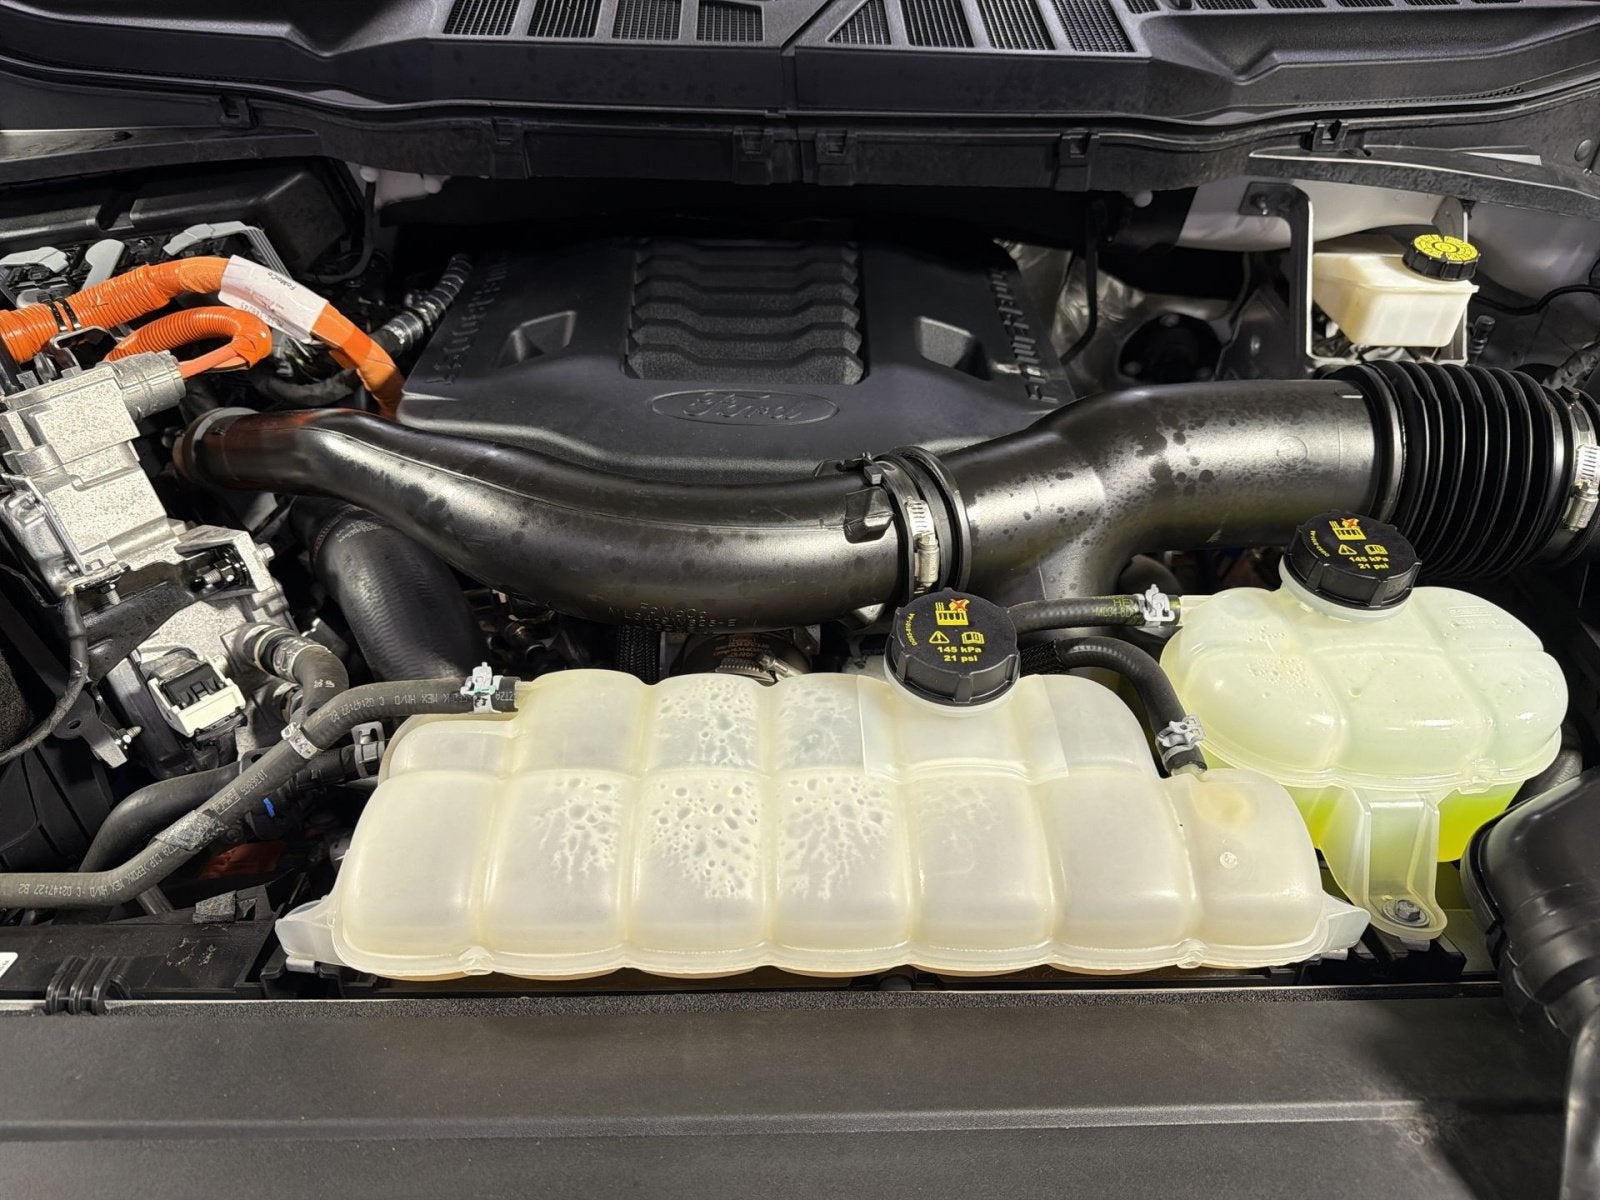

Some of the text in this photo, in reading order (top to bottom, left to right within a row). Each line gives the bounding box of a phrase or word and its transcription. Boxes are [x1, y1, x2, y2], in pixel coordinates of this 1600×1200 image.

[268, 271, 297, 291] FoMoCo
[683, 392, 803, 420] Ford
[960, 655, 978, 663] psi
[33, 883, 72, 897] 02:47:27
